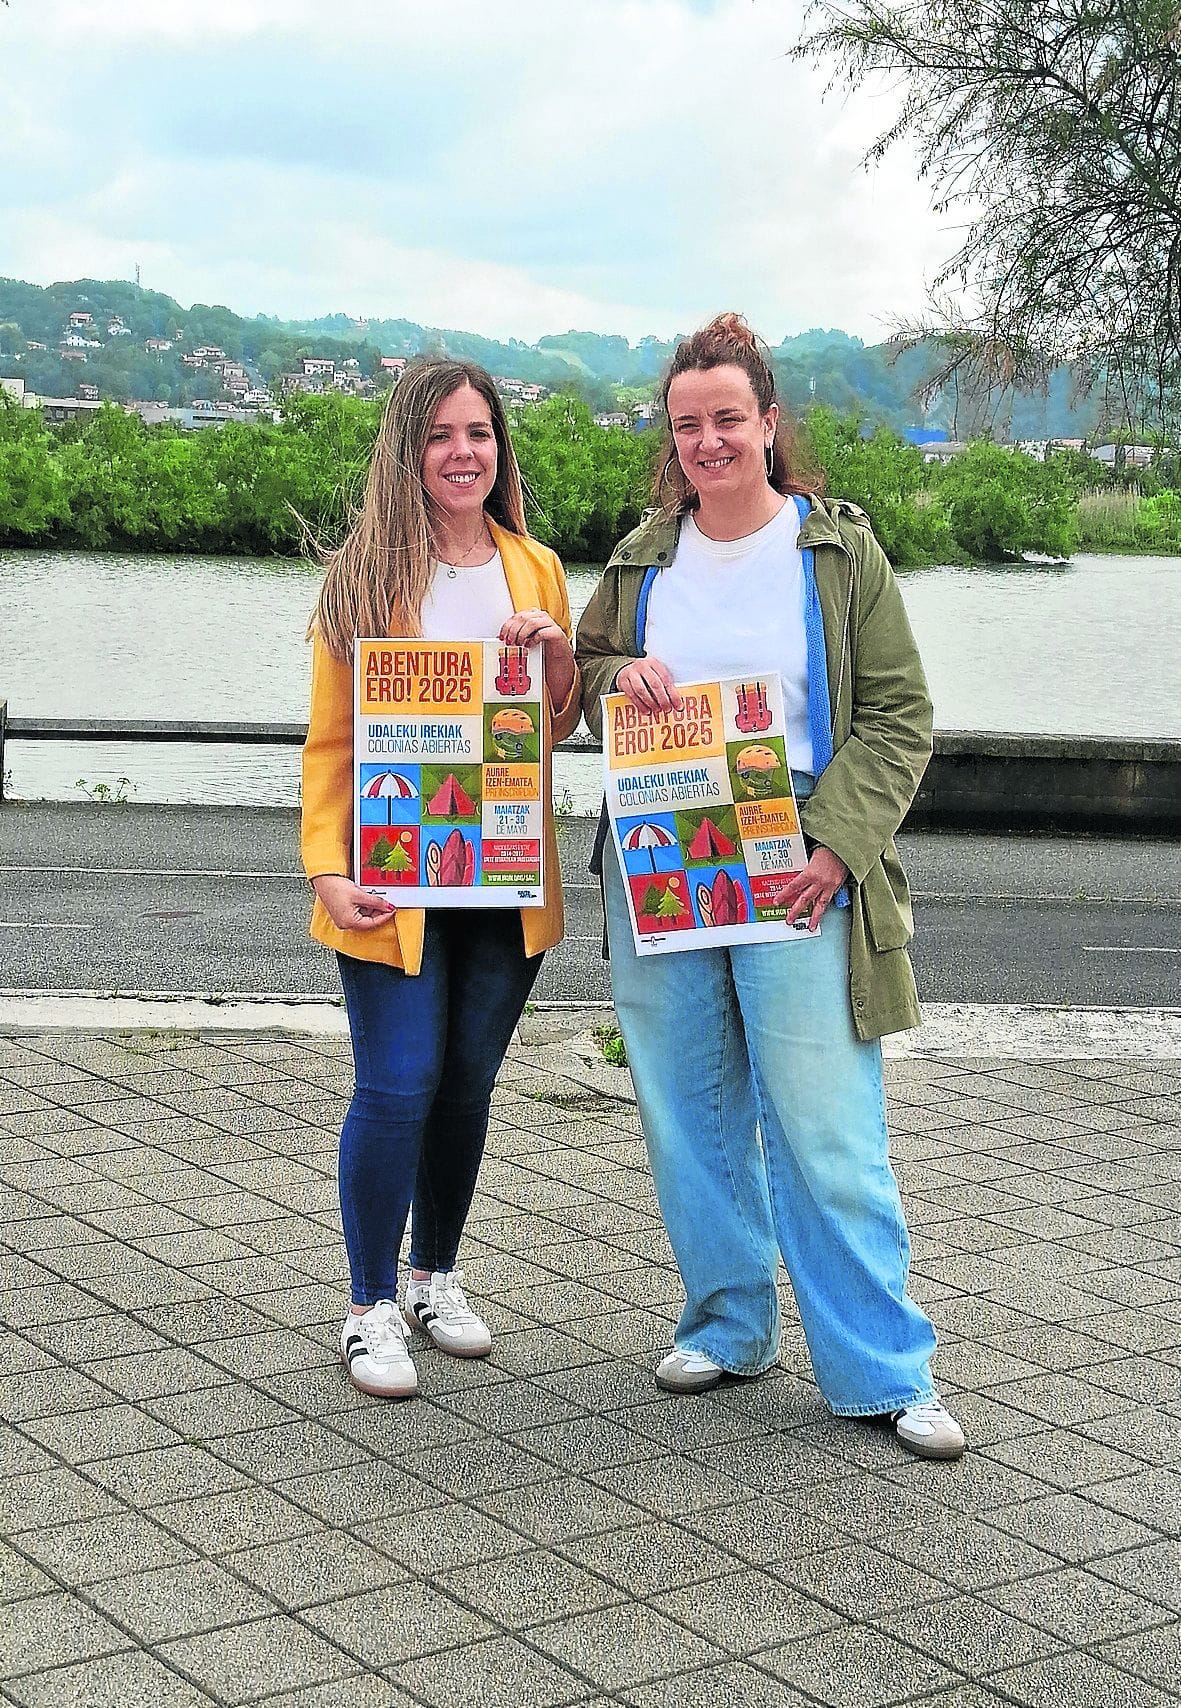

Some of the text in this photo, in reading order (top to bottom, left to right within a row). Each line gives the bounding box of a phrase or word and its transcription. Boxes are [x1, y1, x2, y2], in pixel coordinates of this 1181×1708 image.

[365, 652, 472, 676] ABENTURA
[366, 677, 471, 702] ERO! 2025
[368, 724, 463, 738] UDALEKU IREKIAK
[614, 720, 713, 756] ERO! 2025
[368, 739, 471, 753] COLONIAS ABIERTAS
[485, 767, 509, 777] AURRE
[485, 777, 533, 787] IZEN-EMATEA
[617, 768, 710, 792] UDALEKU IREKIAK
[619, 782, 720, 807] COLONIAS ABIERTAS
[494, 804, 530, 814] MAIATZAK
[739, 804, 763, 816] AURRE
[499, 815, 508, 824] 21
[515, 815, 525, 824] 30
[740, 812, 789, 826] IZEN-EMATEA
[496, 825, 528, 834] DE MAYO
[754, 838, 792, 851] MAIATZAK
[761, 851, 772, 861] 21
[777, 849, 789, 858] 30
[760, 858, 793, 871] DE MAYO
